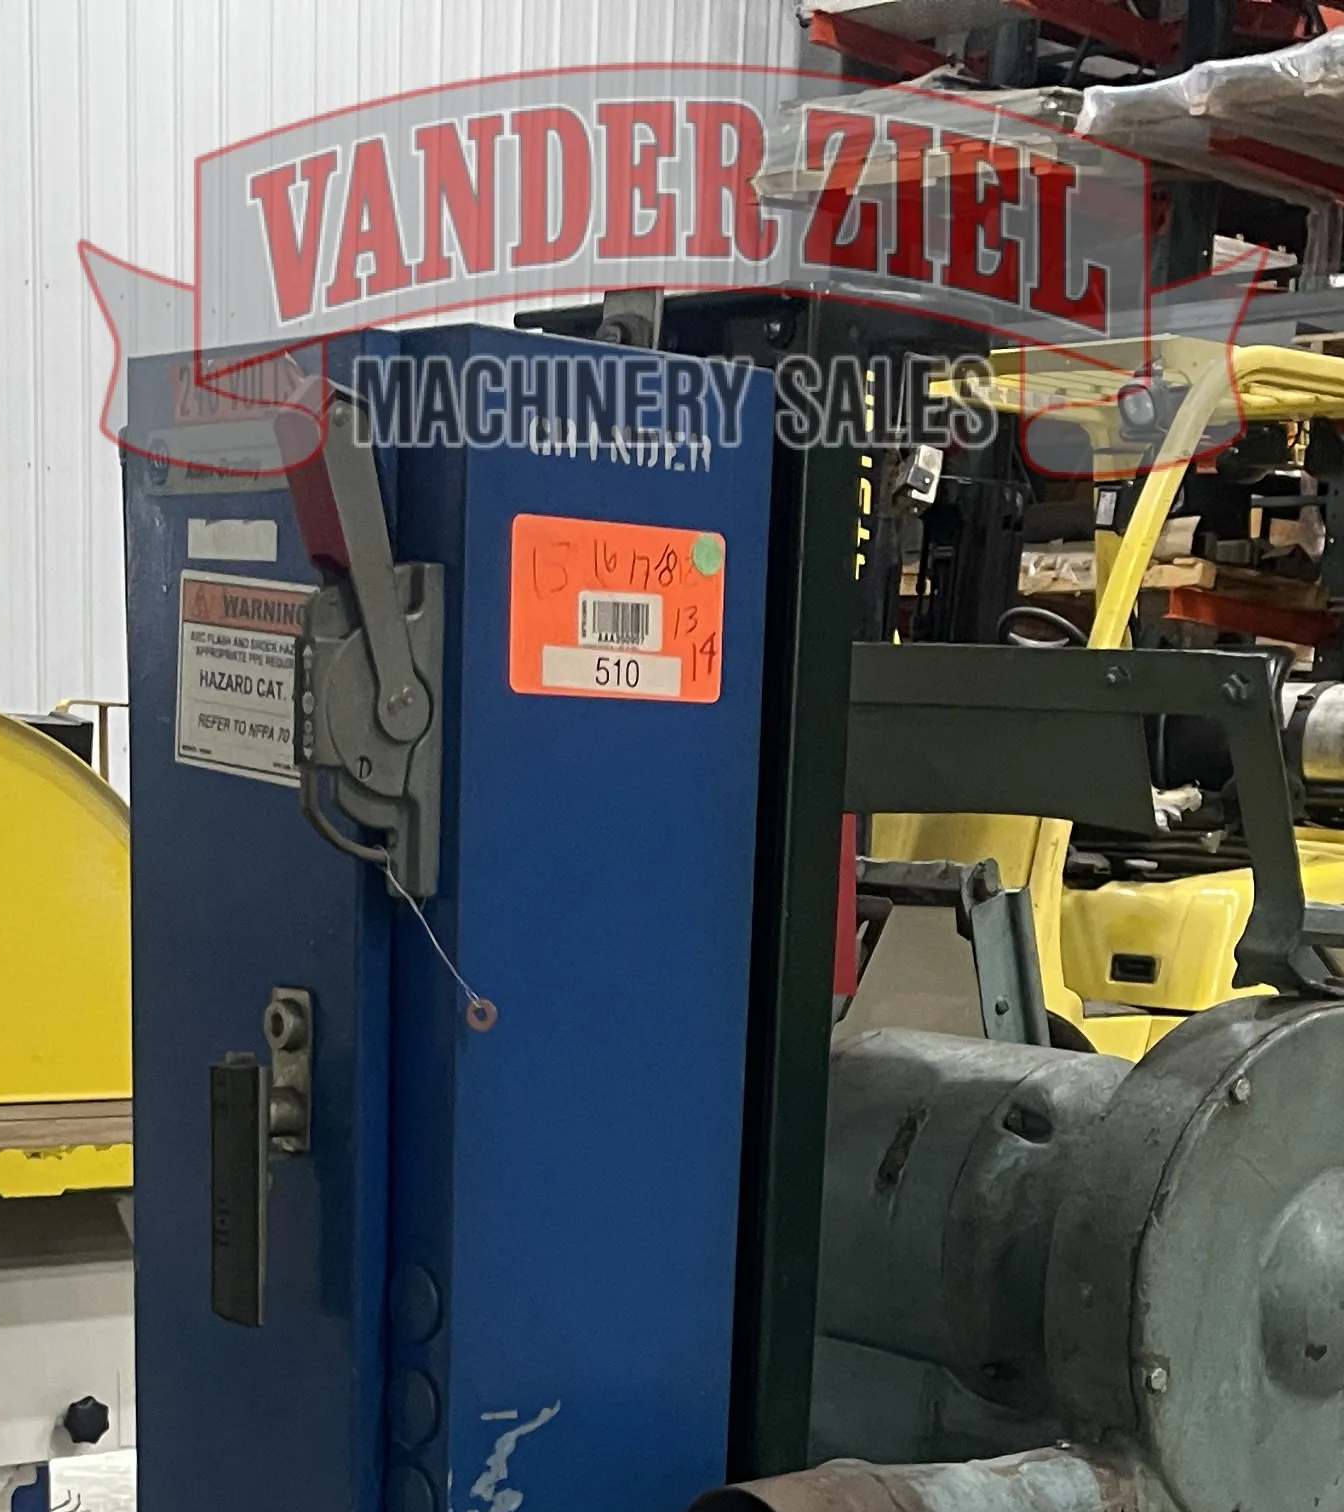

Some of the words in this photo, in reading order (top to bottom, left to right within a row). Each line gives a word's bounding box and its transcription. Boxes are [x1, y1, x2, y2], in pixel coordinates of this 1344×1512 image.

[691, 631, 717, 682] 14
[199, 668, 253, 696] HAZARD
[595, 656, 640, 689] 510
[198, 712, 231, 732] REFER
[233, 719, 247, 736] TO
[248, 722, 275, 741] NFPA
